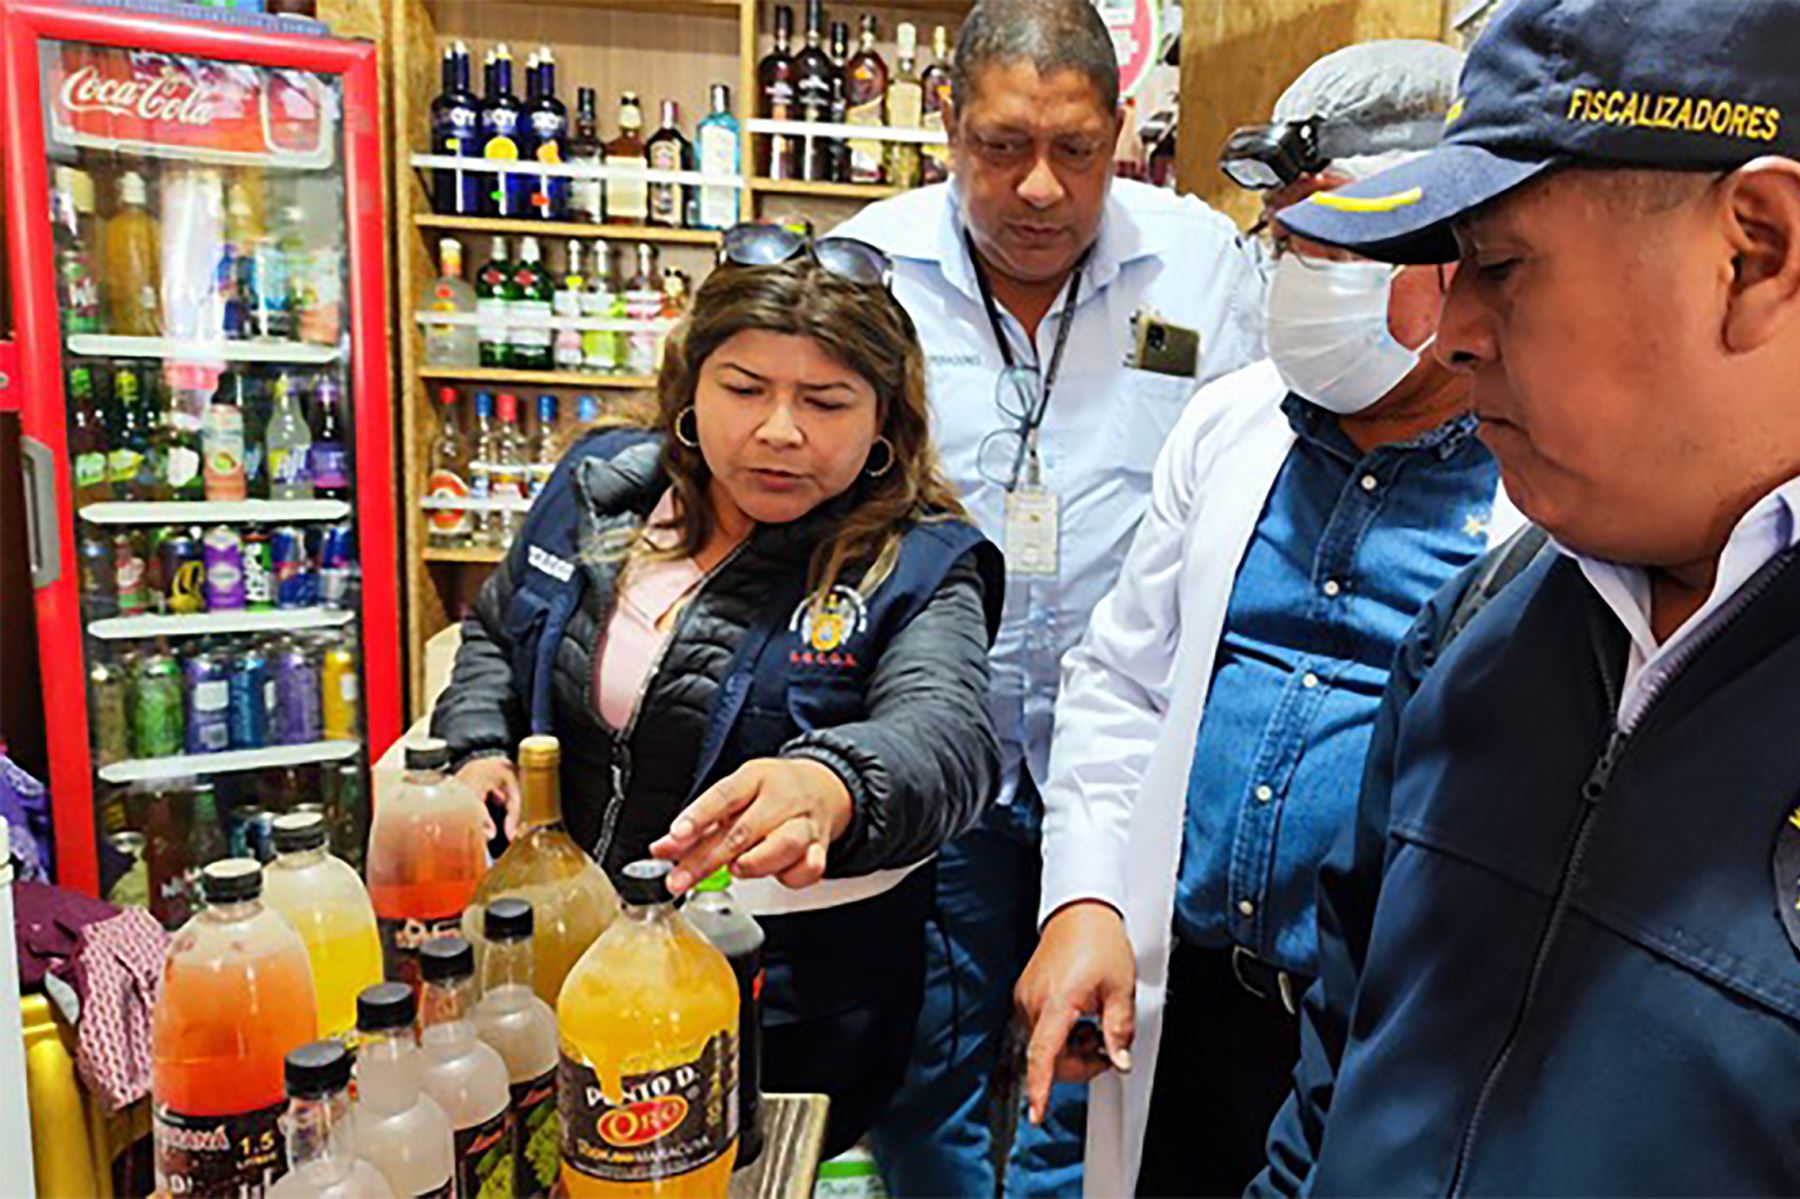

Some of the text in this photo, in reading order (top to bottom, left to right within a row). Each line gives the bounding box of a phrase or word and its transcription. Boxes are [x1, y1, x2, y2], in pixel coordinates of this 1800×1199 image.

[61, 65, 213, 126] Coca-Cola
[1567, 88, 1782, 142] FISCALIZADORES
[239, 1129, 275, 1156] 1.5
